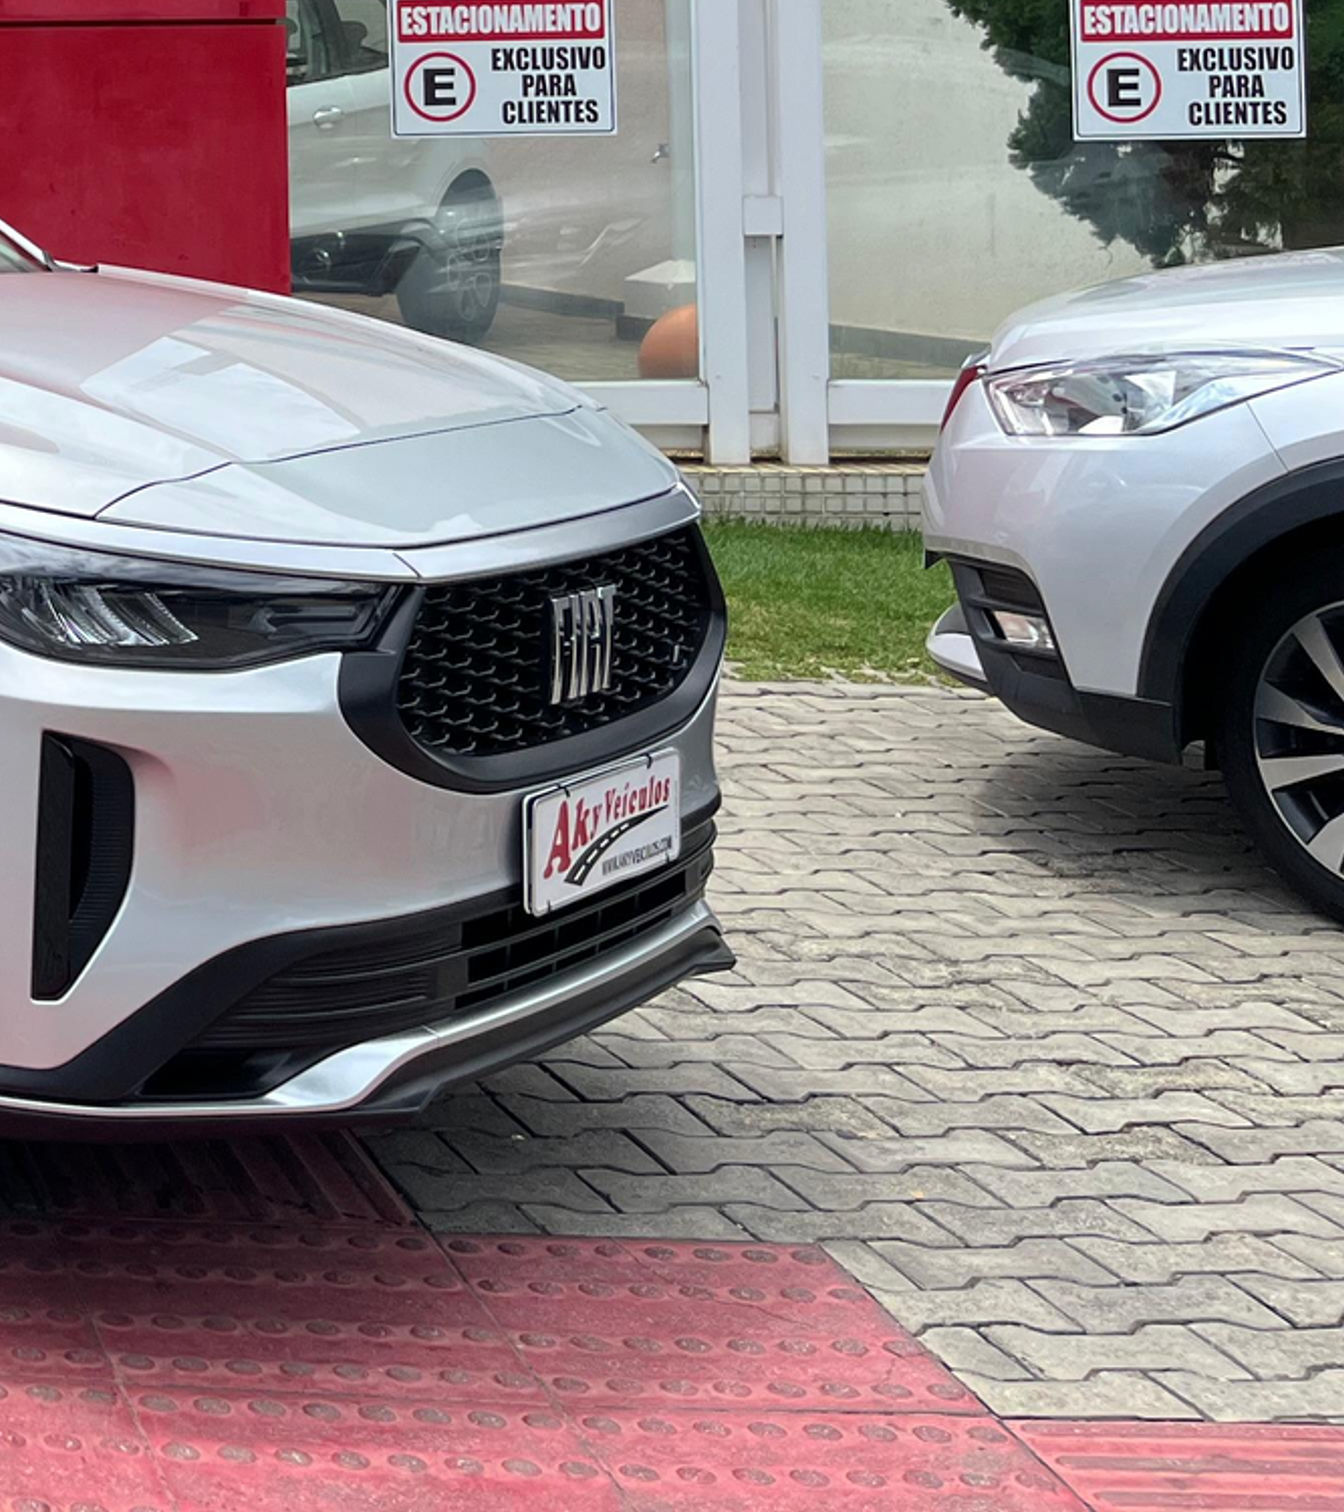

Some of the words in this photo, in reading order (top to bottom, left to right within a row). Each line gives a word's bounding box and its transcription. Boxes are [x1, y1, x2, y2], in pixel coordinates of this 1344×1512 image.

[400, 3, 601, 35] ESTACIONAMENTO
[1083, 2, 1289, 35] ESTACIONAMENTO
[491, 46, 606, 71] EXCLUSIVO
[1177, 46, 1294, 71] EXCLUSIVO
[422, 68, 457, 106] E
[521, 74, 577, 97] PARA
[1106, 68, 1141, 107] E
[1209, 75, 1265, 98] PARA
[502, 99, 599, 124] CLIENTES
[1188, 101, 1287, 126] CLIENTES
[550, 585, 616, 705] FIAT
[543, 796, 603, 879] Aky
[604, 775, 671, 823] Veículos
